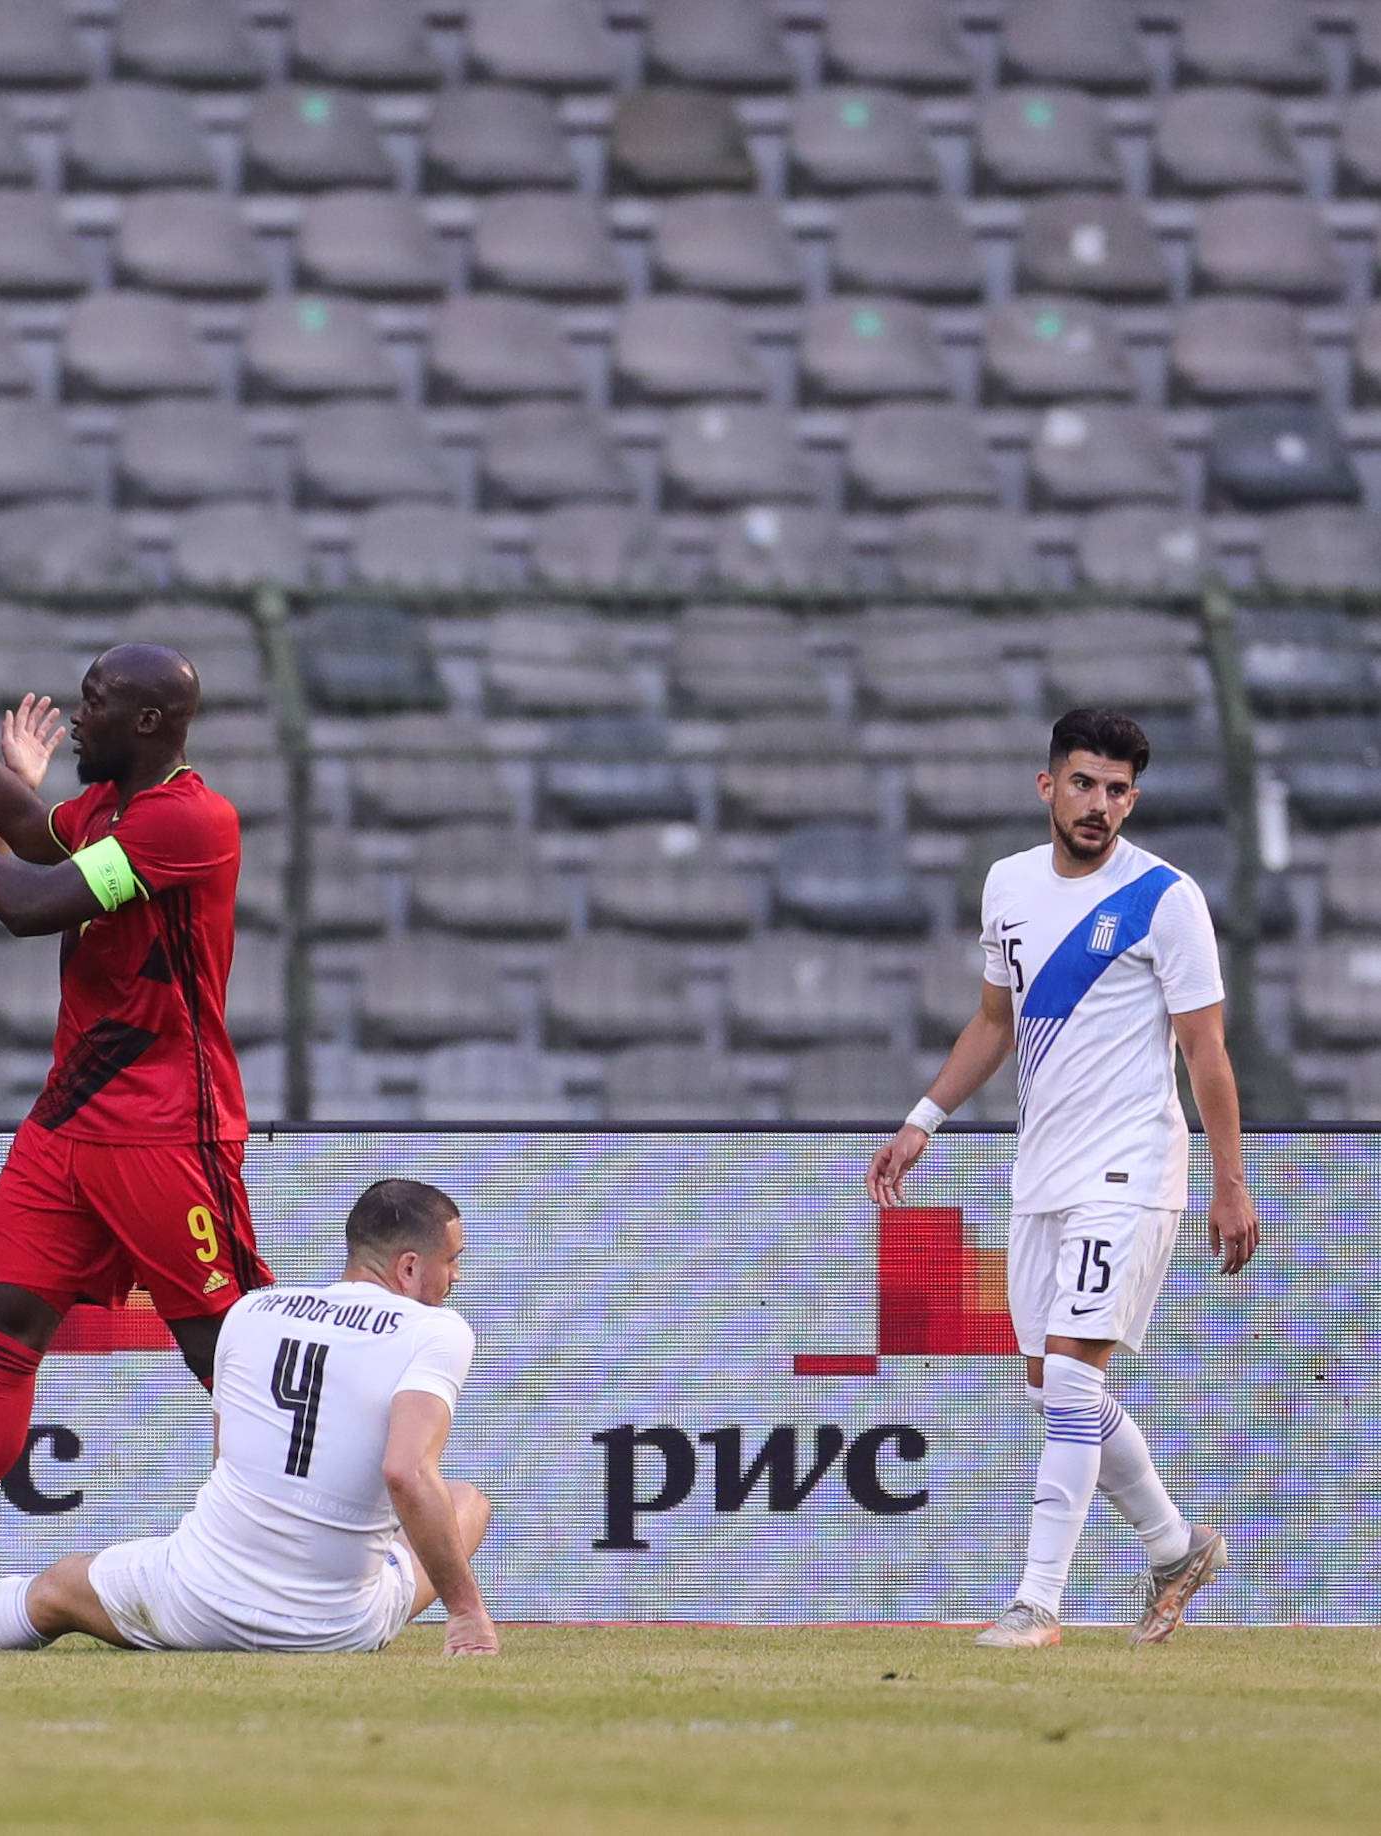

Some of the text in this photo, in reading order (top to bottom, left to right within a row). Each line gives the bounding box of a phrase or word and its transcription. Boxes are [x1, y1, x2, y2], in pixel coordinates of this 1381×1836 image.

[1001, 938, 1024, 993] 15
[186, 1205, 219, 1263] 9
[1077, 1240, 1113, 1293] 15
[247, 1294, 404, 1335] PAPADOPOULOS
[270, 1337, 330, 1478] 4
[592, 1425, 929, 1551] pwc
